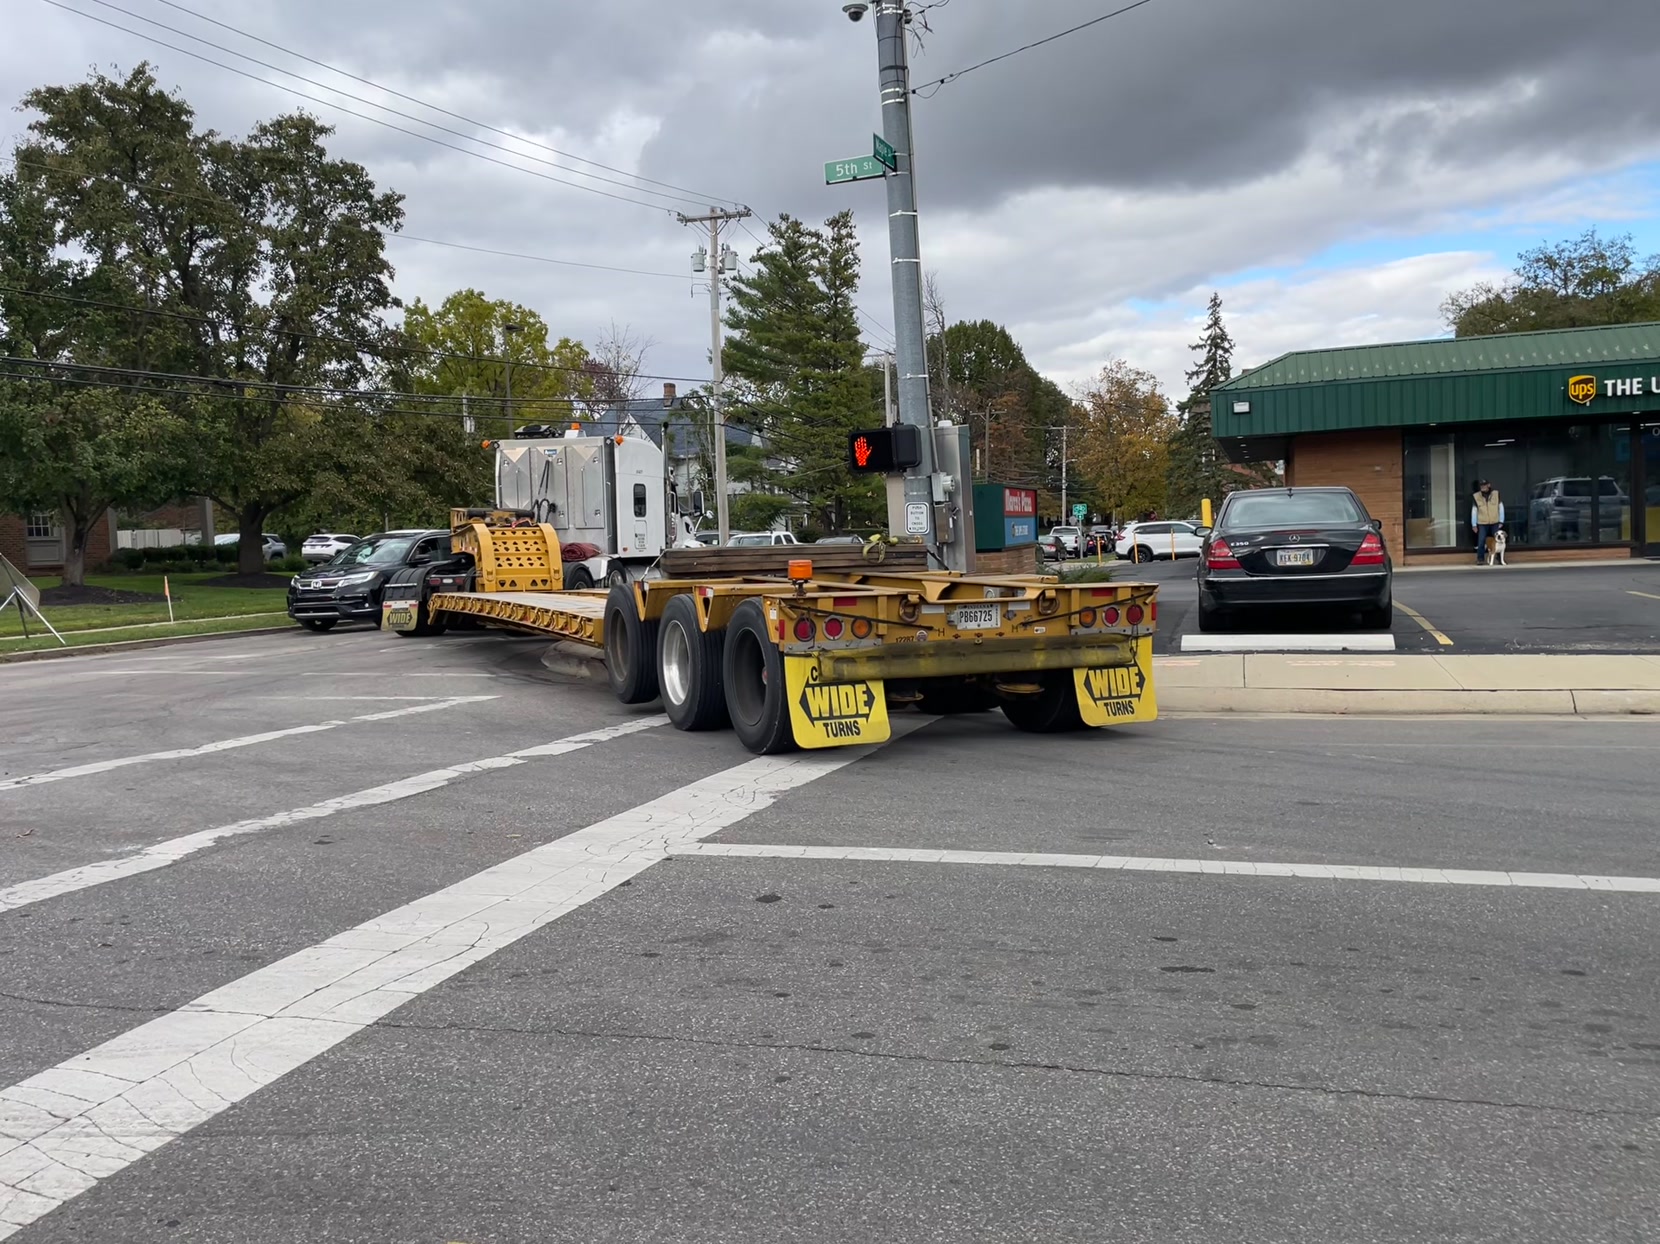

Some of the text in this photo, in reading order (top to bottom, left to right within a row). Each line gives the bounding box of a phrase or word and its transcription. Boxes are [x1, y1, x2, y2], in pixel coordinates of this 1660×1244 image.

[836, 161, 873, 177] 5th St
[1571, 383, 1594, 399] ups
[1604, 377, 1643, 397] THE
[389, 612, 411, 624] WIDE
[1088, 666, 1142, 699] WIDE
[805, 683, 870, 718] WIDE
[1103, 700, 1135, 717] TURNS
[823, 719, 861, 738] TURNS
